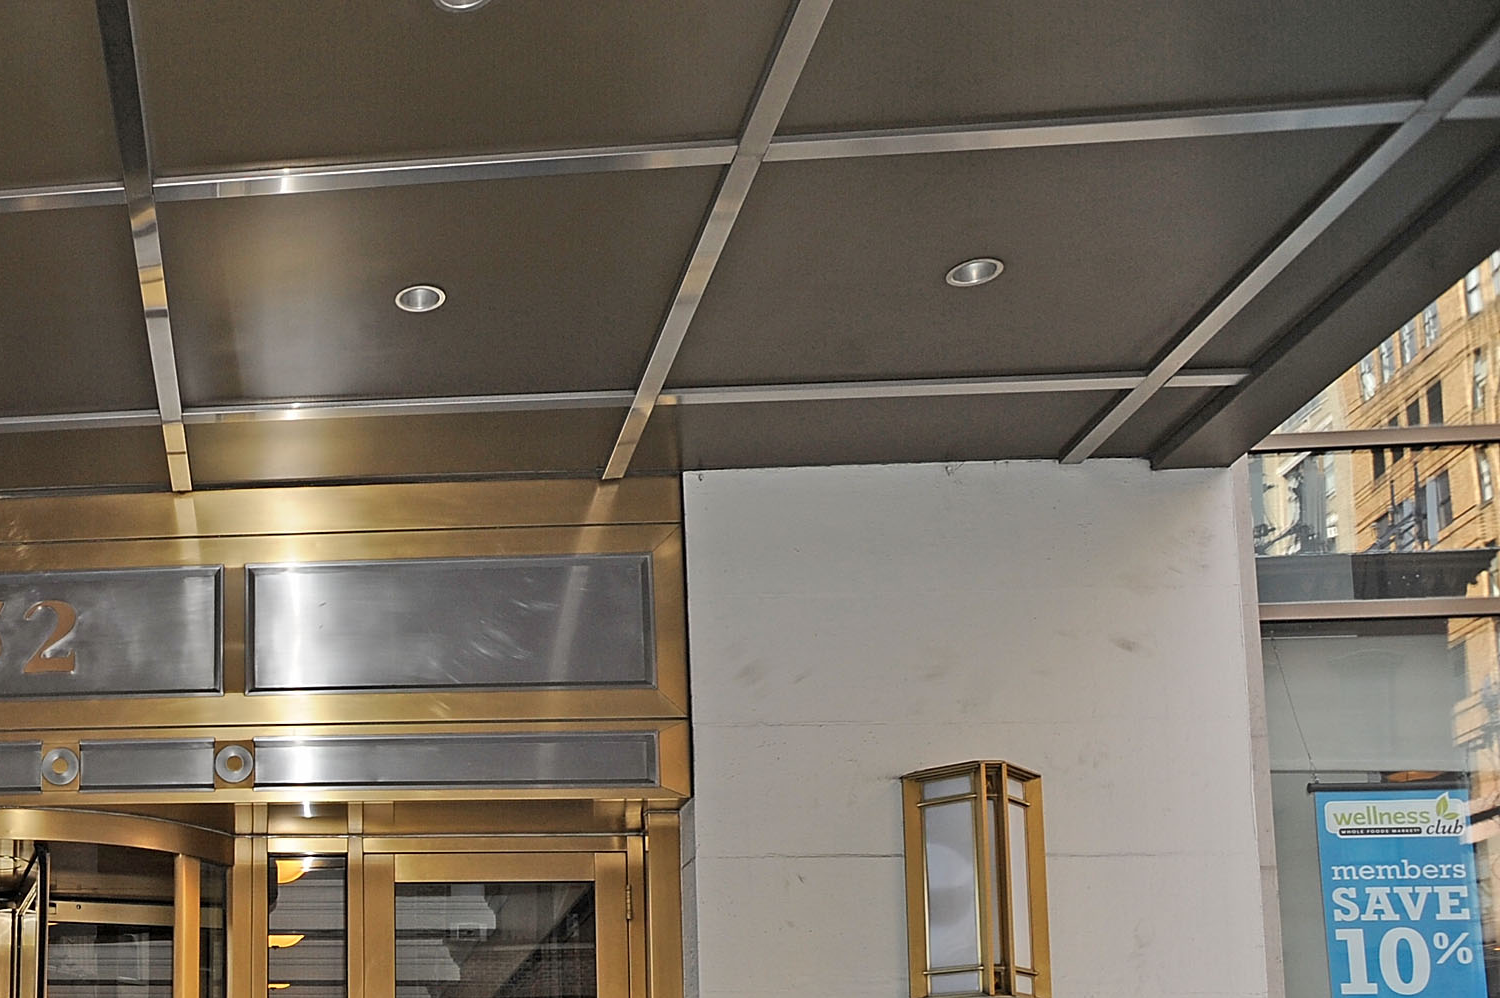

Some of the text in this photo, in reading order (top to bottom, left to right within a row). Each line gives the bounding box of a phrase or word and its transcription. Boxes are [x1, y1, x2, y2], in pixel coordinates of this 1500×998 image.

[1333, 806, 1430, 826] wellness
[1426, 819, 1464, 835] club
[1332, 859, 1466, 880] members
[1332, 885, 1471, 922] SAVE
[1335, 927, 1474, 995] 10%
